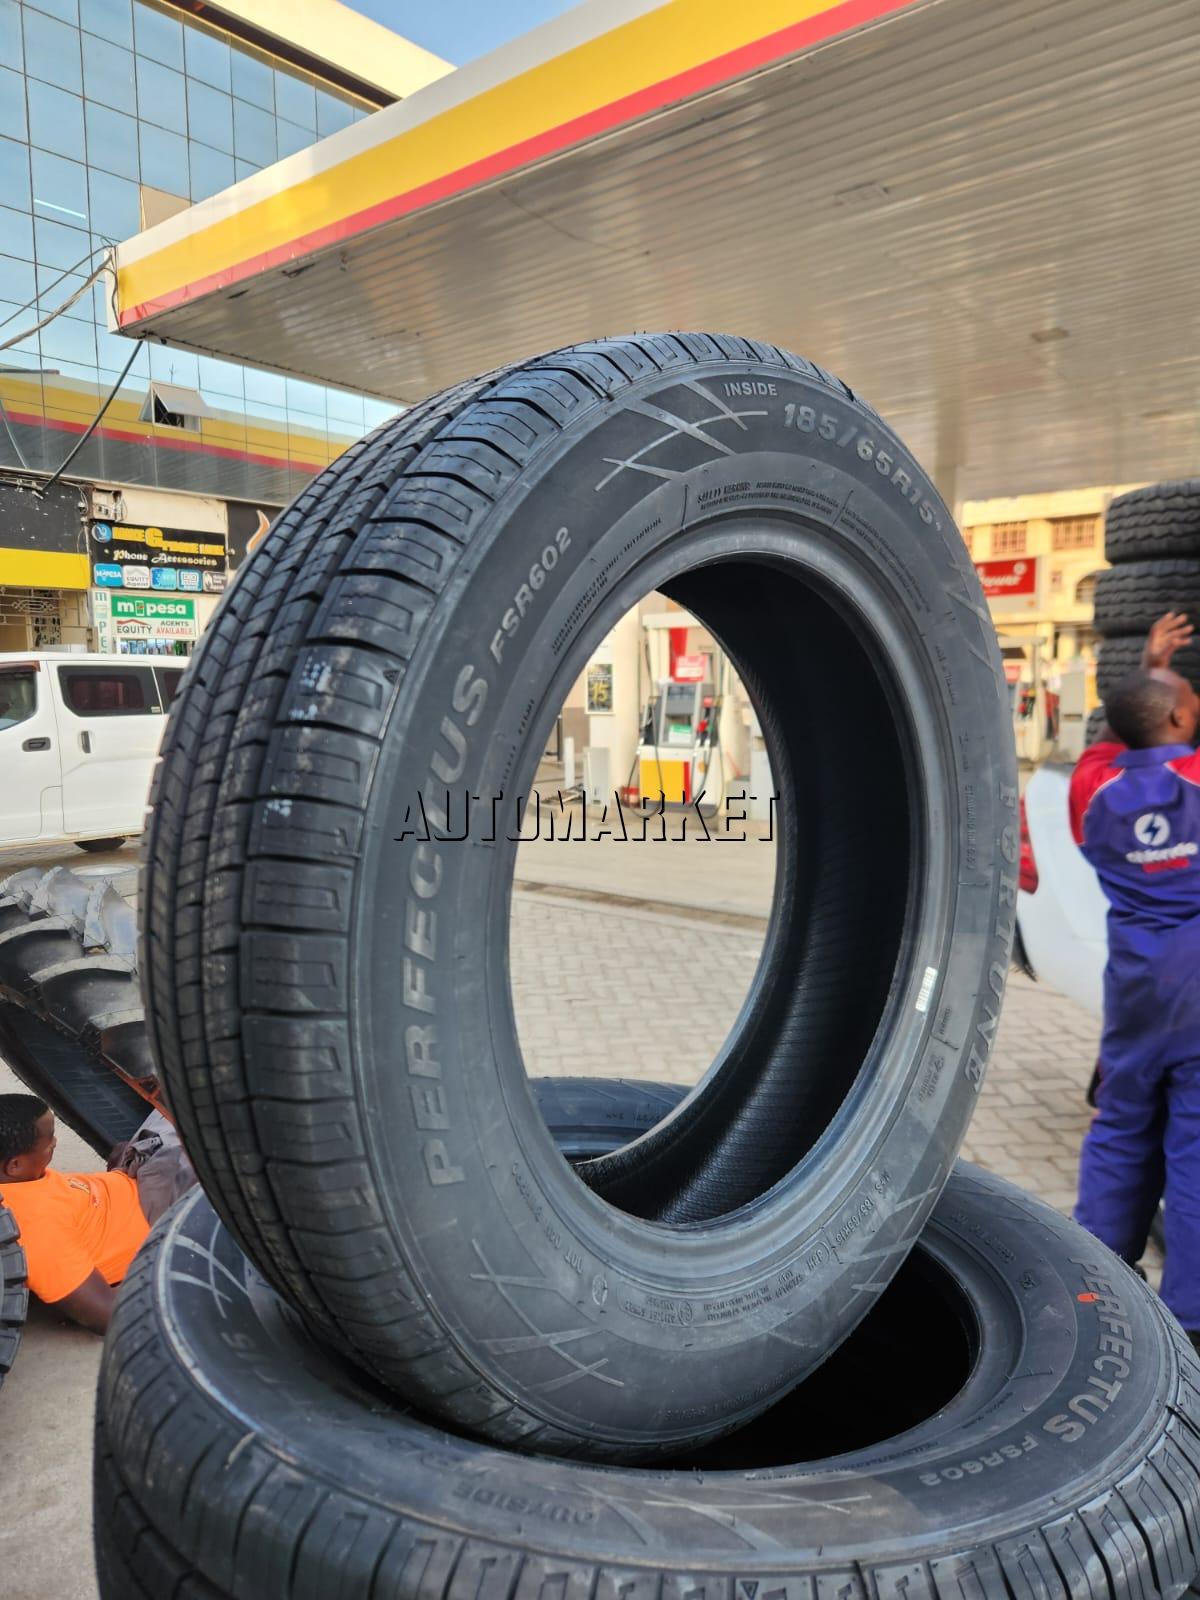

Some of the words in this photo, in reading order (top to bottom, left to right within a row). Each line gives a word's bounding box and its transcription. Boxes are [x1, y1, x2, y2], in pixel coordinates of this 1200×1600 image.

[723, 381, 778, 398] INSIDE
[113, 549, 149, 561] Phone
[151, 553, 218, 567] Accessories
[489, 526, 573, 665] FSR602
[116, 624, 153, 635] EQUITY
[156, 626, 193, 636] AVAILABLE
[403, 664, 488, 1187] PERFECTUS
[1043, 1257, 1134, 1444] PERFECTUS
[918, 1433, 1040, 1487] FSR602
